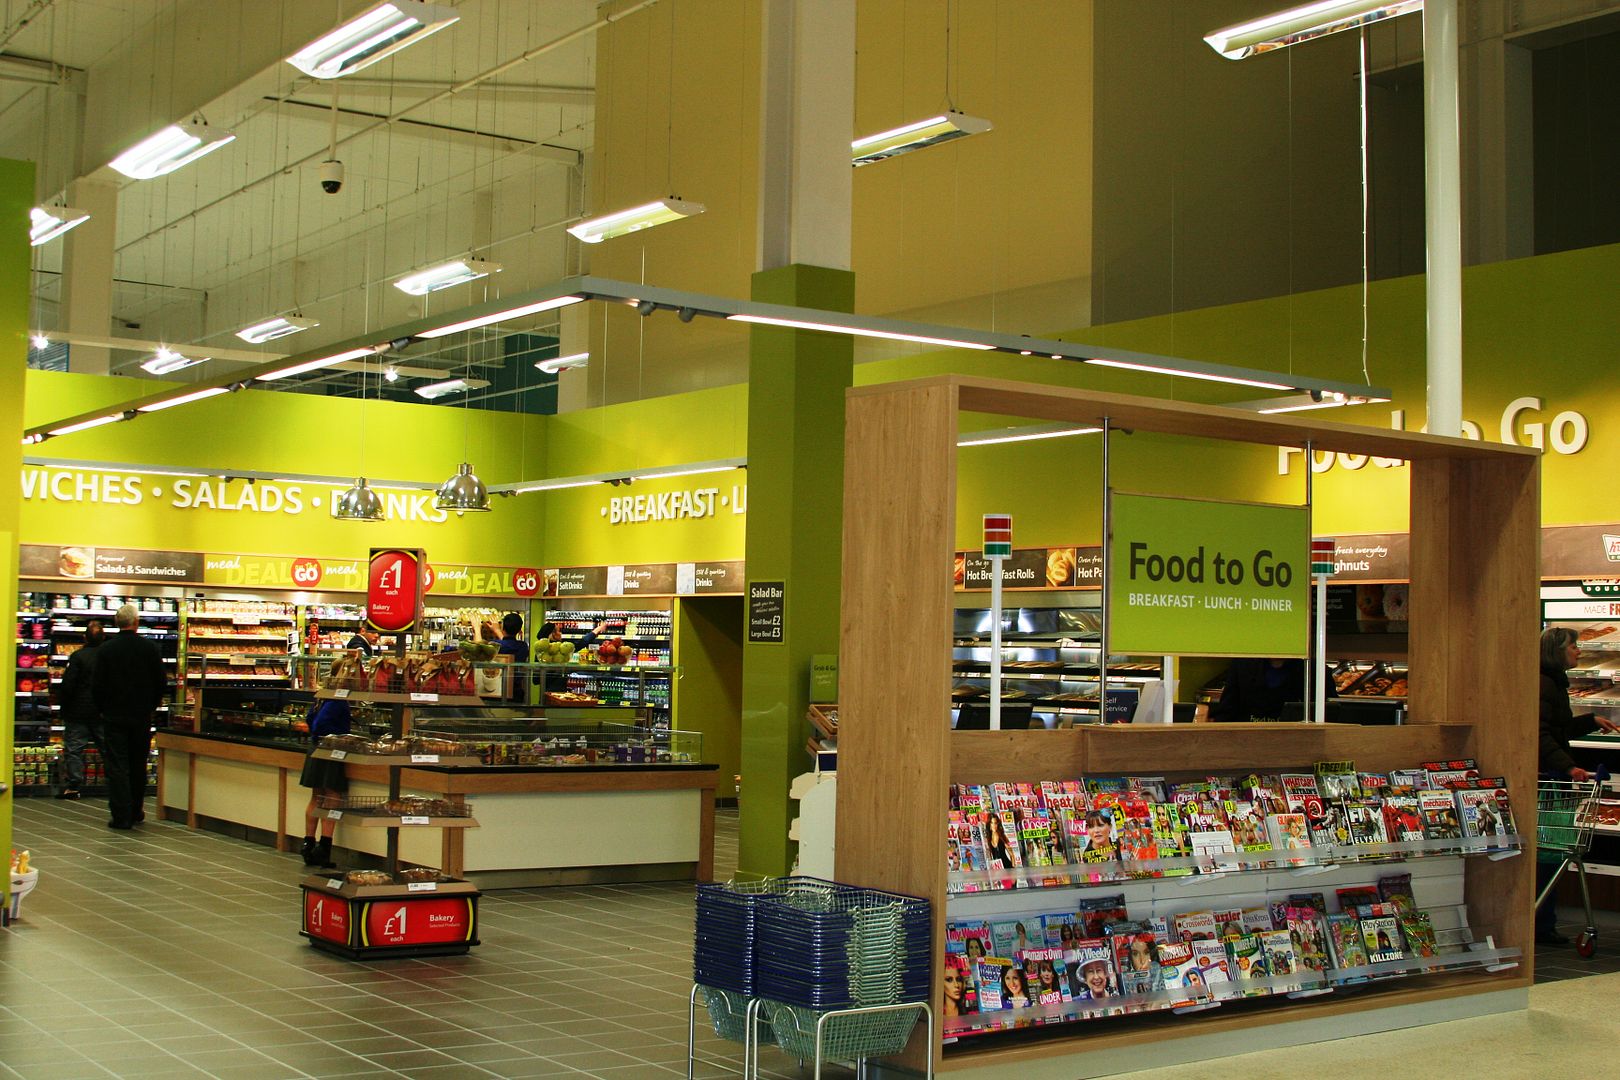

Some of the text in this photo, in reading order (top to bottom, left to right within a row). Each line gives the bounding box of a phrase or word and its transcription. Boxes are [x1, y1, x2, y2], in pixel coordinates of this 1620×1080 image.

[1500, 397, 1589, 456] Go
[172, 479, 304, 515] SALADS
[609, 488, 719, 525] BREAKFAST
[1334, 545, 1388, 558] fresh everyday
[206, 555, 241, 570] meal
[1078, 556, 1091, 564] Oven
[1129, 541, 1293, 588] Food to Go
[96, 563, 187, 577] Salads & Sandwiches
[226, 561, 293, 585] DEAL
[295, 567, 319, 582] GO
[325, 561, 358, 575] meal
[379, 560, 403, 589] £1
[437, 566, 468, 580] meal
[966, 568, 1035, 580] Hot Brefast Rolls
[1077, 567, 1093, 578] Hot
[455, 572, 515, 594] DEAL
[516, 578, 537, 591] GO
[568, 581, 583, 590] Drinks
[624, 579, 640, 589] Drinks
[695, 577, 713, 587] Drinks
[751, 587, 783, 599] Salad Bar
[372, 603, 391, 612] Bakery
[1128, 592, 1293, 612] BREAKFAST LUNCH DINNER
[1583, 605, 1607, 614] MADE
[772, 615, 781, 626] £2
[751, 630, 762, 638] Large
[771, 627, 781, 638] £3
[1105, 696, 1117, 704] Self
[1105, 704, 1128, 712] Service
[997, 794, 1026, 811] heat
[1044, 793, 1074, 809] heat
[1022, 818, 1051, 832] Closer
[311, 899, 323, 927] £1
[331, 912, 343, 923] Bakery
[429, 914, 455, 923] Bakery
[383, 906, 407, 936] £1
[1181, 917, 1213, 929] Crosswords
[1022, 948, 1063, 960] Woman's Own
[1084, 946, 1112, 962] Weekly
[1369, 951, 1404, 963] KILLZONE
[1039, 991, 1061, 1005] UNDER
